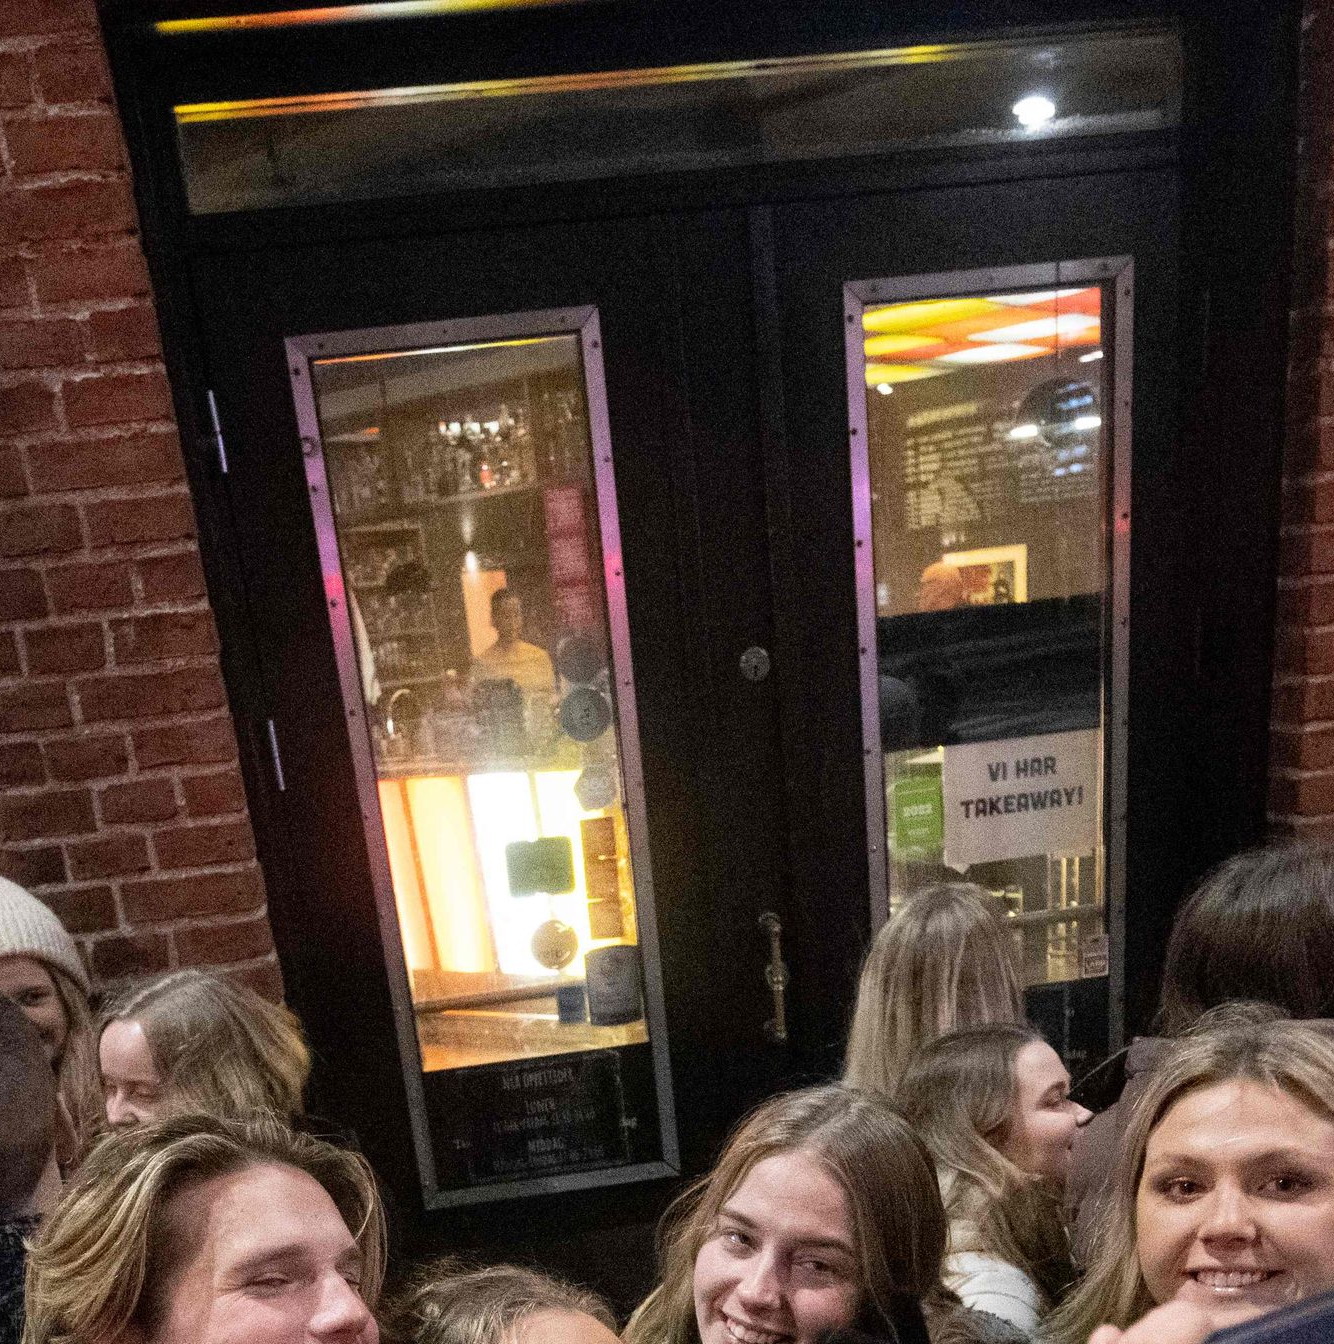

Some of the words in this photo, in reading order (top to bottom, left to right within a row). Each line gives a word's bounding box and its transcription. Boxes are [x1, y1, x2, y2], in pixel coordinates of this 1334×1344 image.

[987, 761, 1008, 782] VI
[1014, 756, 1058, 780] HAR
[960, 785, 1085, 818] TAKEAWAY!
